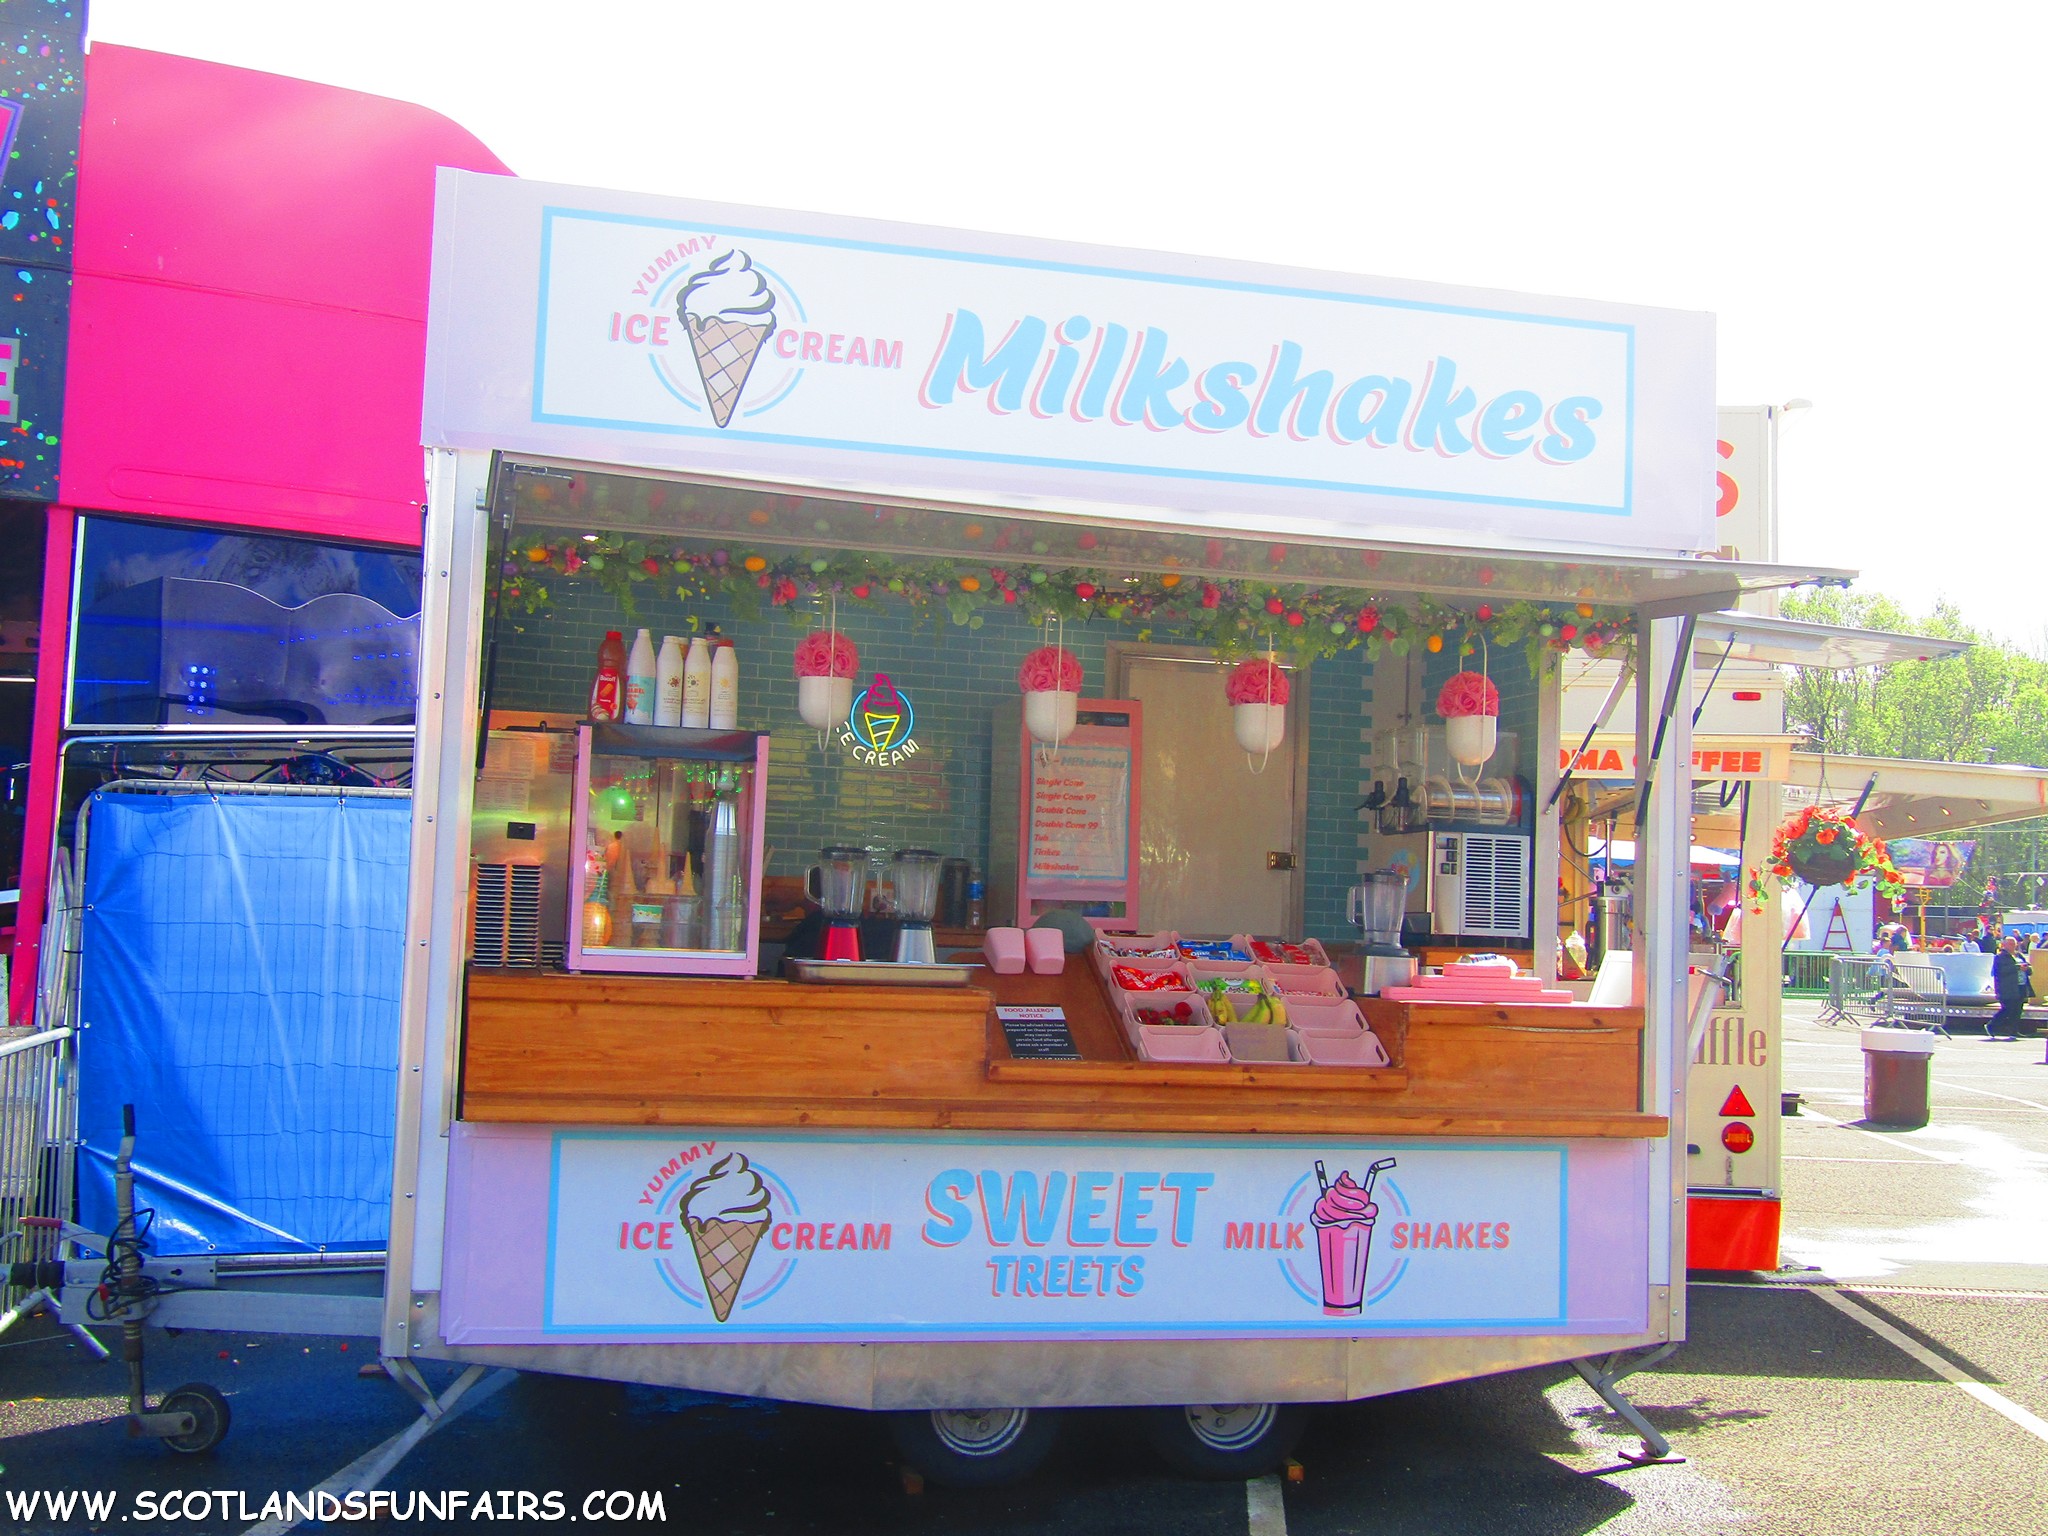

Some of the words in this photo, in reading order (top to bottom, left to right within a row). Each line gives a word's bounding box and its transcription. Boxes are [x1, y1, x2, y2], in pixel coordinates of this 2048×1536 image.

[632, 235, 717, 297] YUMMY
[608, 311, 671, 347] ICE
[774, 328, 904, 369] CREAM
[918, 308, 1602, 466] Milkshakes
[852, 738, 920, 767] CREAM
[1036, 778, 1061, 787] Single
[1063, 779, 1084, 787] Cone
[1036, 792, 1061, 801] Single
[1063, 793, 1084, 801] Cone
[1035, 806, 1064, 814] Double
[1065, 807, 1087, 815] Cone
[1035, 820, 1064, 828] Double
[1065, 821, 1086, 829] Cone
[1033, 862, 1079, 871] Milkshakes
[638, 1141, 717, 1206] YUMMY
[921, 1167, 1215, 1248] SWEET
[618, 1222, 675, 1250] ICE
[770, 1222, 893, 1251] CREAM
[1224, 1221, 1305, 1250] MILK
[1388, 1221, 1511, 1250] SHAKES
[986, 1254, 1146, 1298] TREETS
